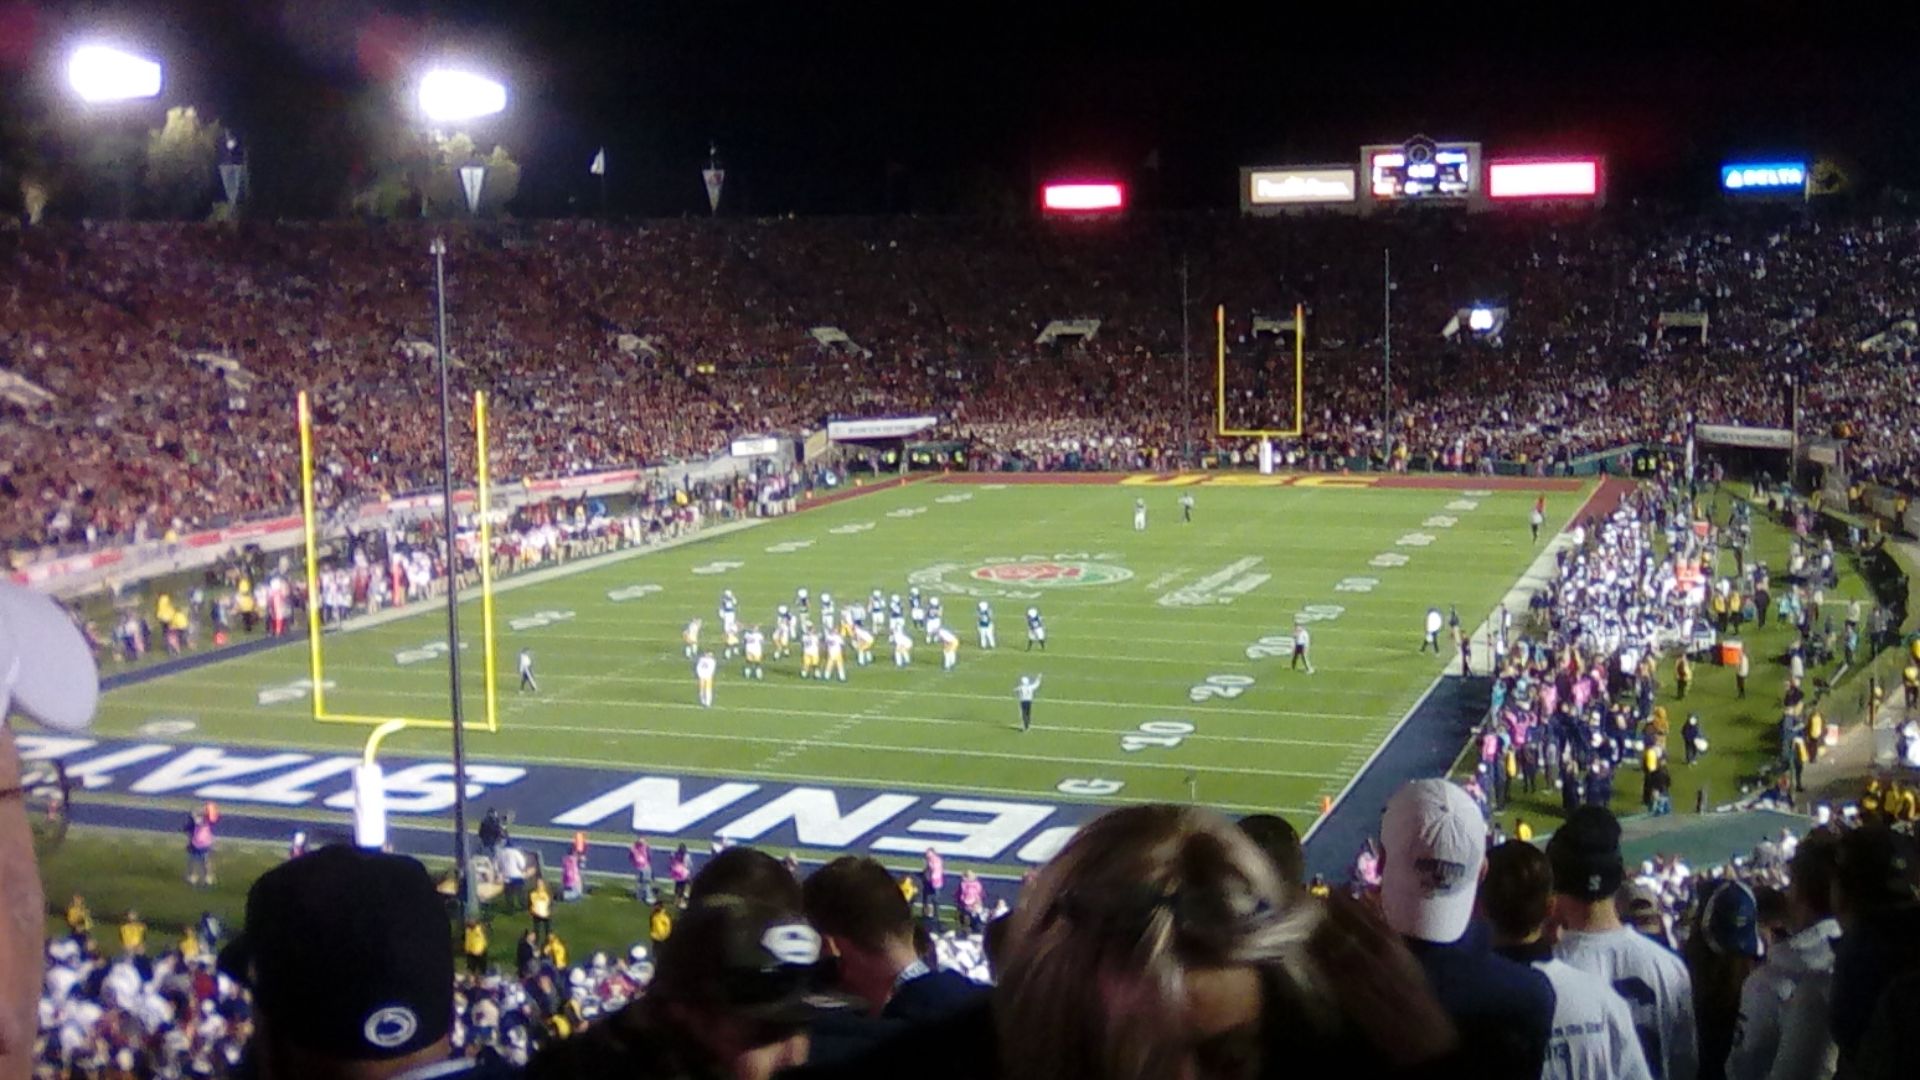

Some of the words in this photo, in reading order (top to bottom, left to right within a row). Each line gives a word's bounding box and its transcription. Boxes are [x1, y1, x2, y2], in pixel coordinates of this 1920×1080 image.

[1743, 167, 1802, 187] DELTA
[1119, 474, 1380, 488] USC
[1189, 674, 1256, 702] 20
[1121, 721, 1195, 752] 10
[1056, 777, 1125, 795] G
